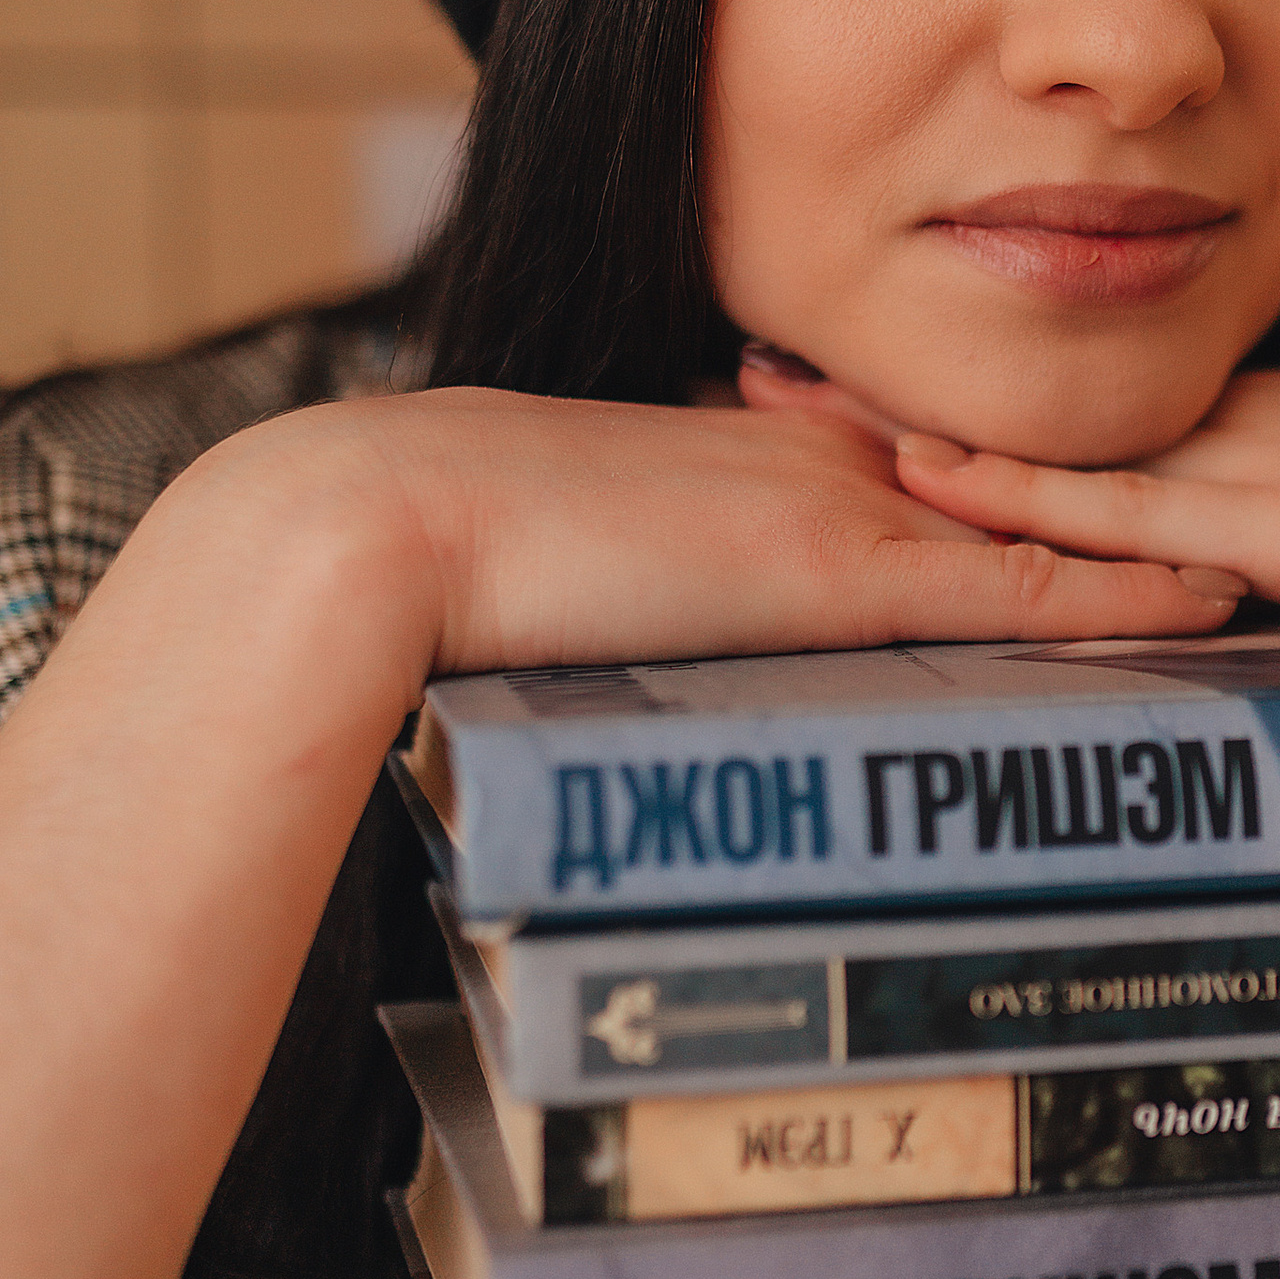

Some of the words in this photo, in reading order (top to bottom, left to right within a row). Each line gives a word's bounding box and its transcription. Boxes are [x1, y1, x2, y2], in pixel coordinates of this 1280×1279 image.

[551, 755, 830, 893] ДЖОН
[863, 737, 1261, 857] ГРИШЭМ
[969, 978, 1054, 1019] ЗЛО
[737, 1114, 854, 1174] ГРЭМ
[882, 1107, 917, 1163] Х
[1133, 1098, 1250, 1138] ночь
